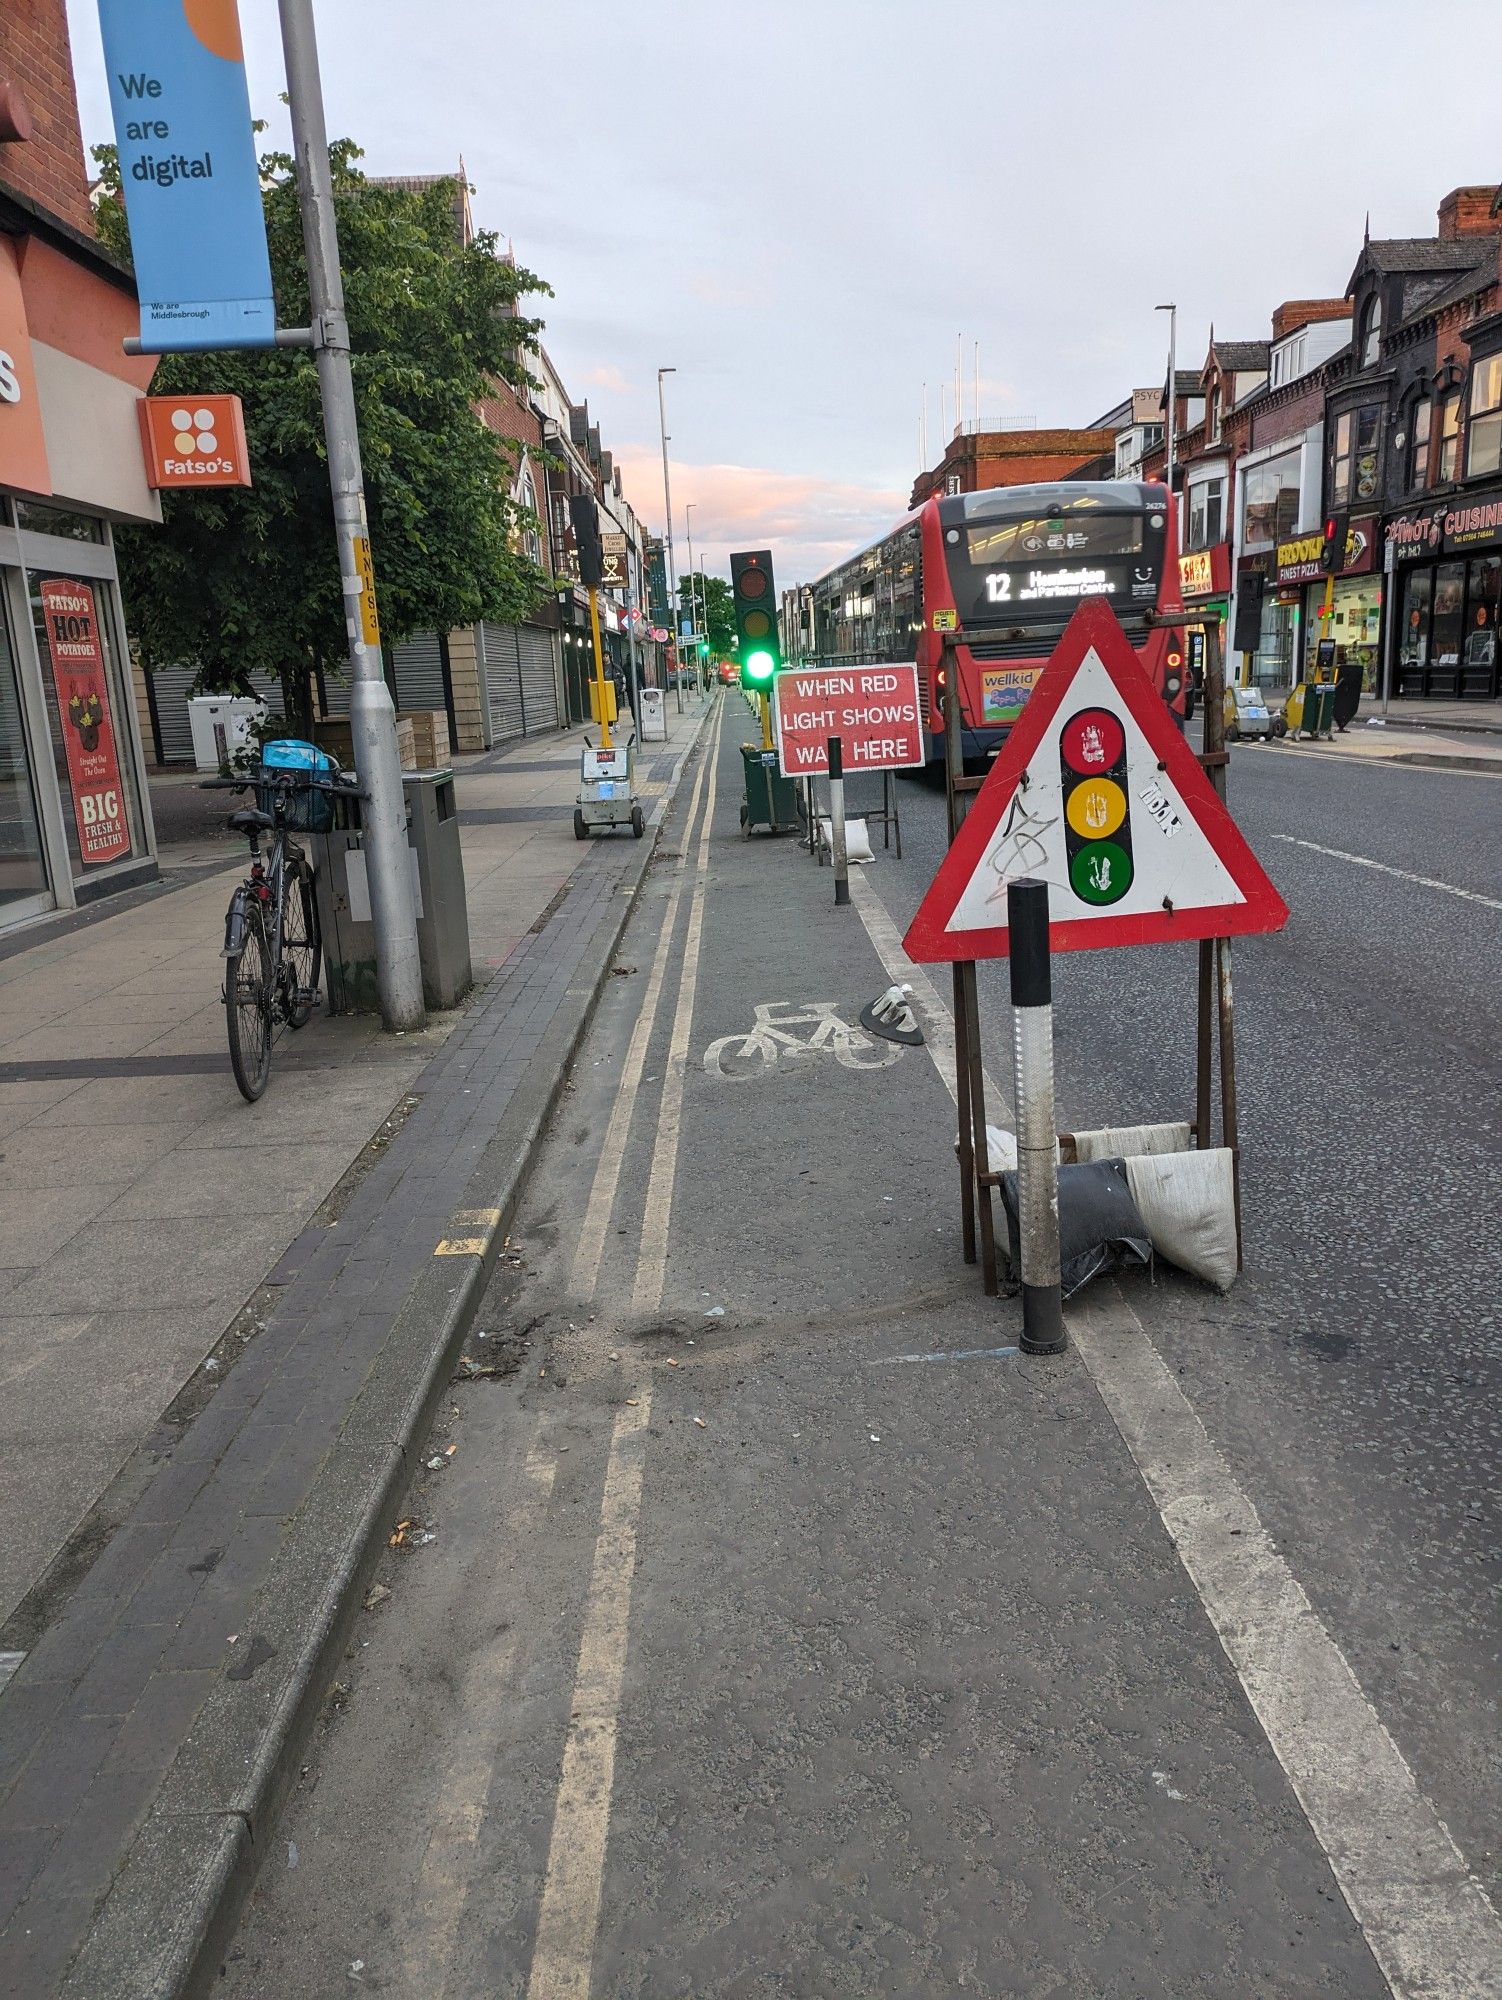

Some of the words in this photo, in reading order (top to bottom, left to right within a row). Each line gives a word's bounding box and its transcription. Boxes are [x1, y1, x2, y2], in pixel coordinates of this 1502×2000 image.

[118, 73, 162, 99] We
[126, 120, 169, 141] are
[132, 152, 213, 187] digital
[151, 310, 210, 320] Middlesbrough
[164, 457, 234, 475] Fatso's
[1280, 566, 1300, 581] FINEST
[1301, 562, 1319, 577] PIZZA
[985, 572, 1011, 602] 12
[48, 594, 89, 612] FATSO'S
[52, 615, 92, 643] HOT
[56, 643, 96, 656] POTATOES
[796, 677, 854, 697] WHEN
[861, 674, 898, 693] RED
[985, 672, 1033, 686] wellkid
[783, 710, 837, 730] LIGHT
[842, 705, 915, 726] SHOWS
[853, 738, 909, 761] HERE
[80, 790, 119, 825] BIG
[84, 821, 113, 838] FRESH
[114, 820, 121, 831] &
[87, 832, 123, 852] HEALTHY
